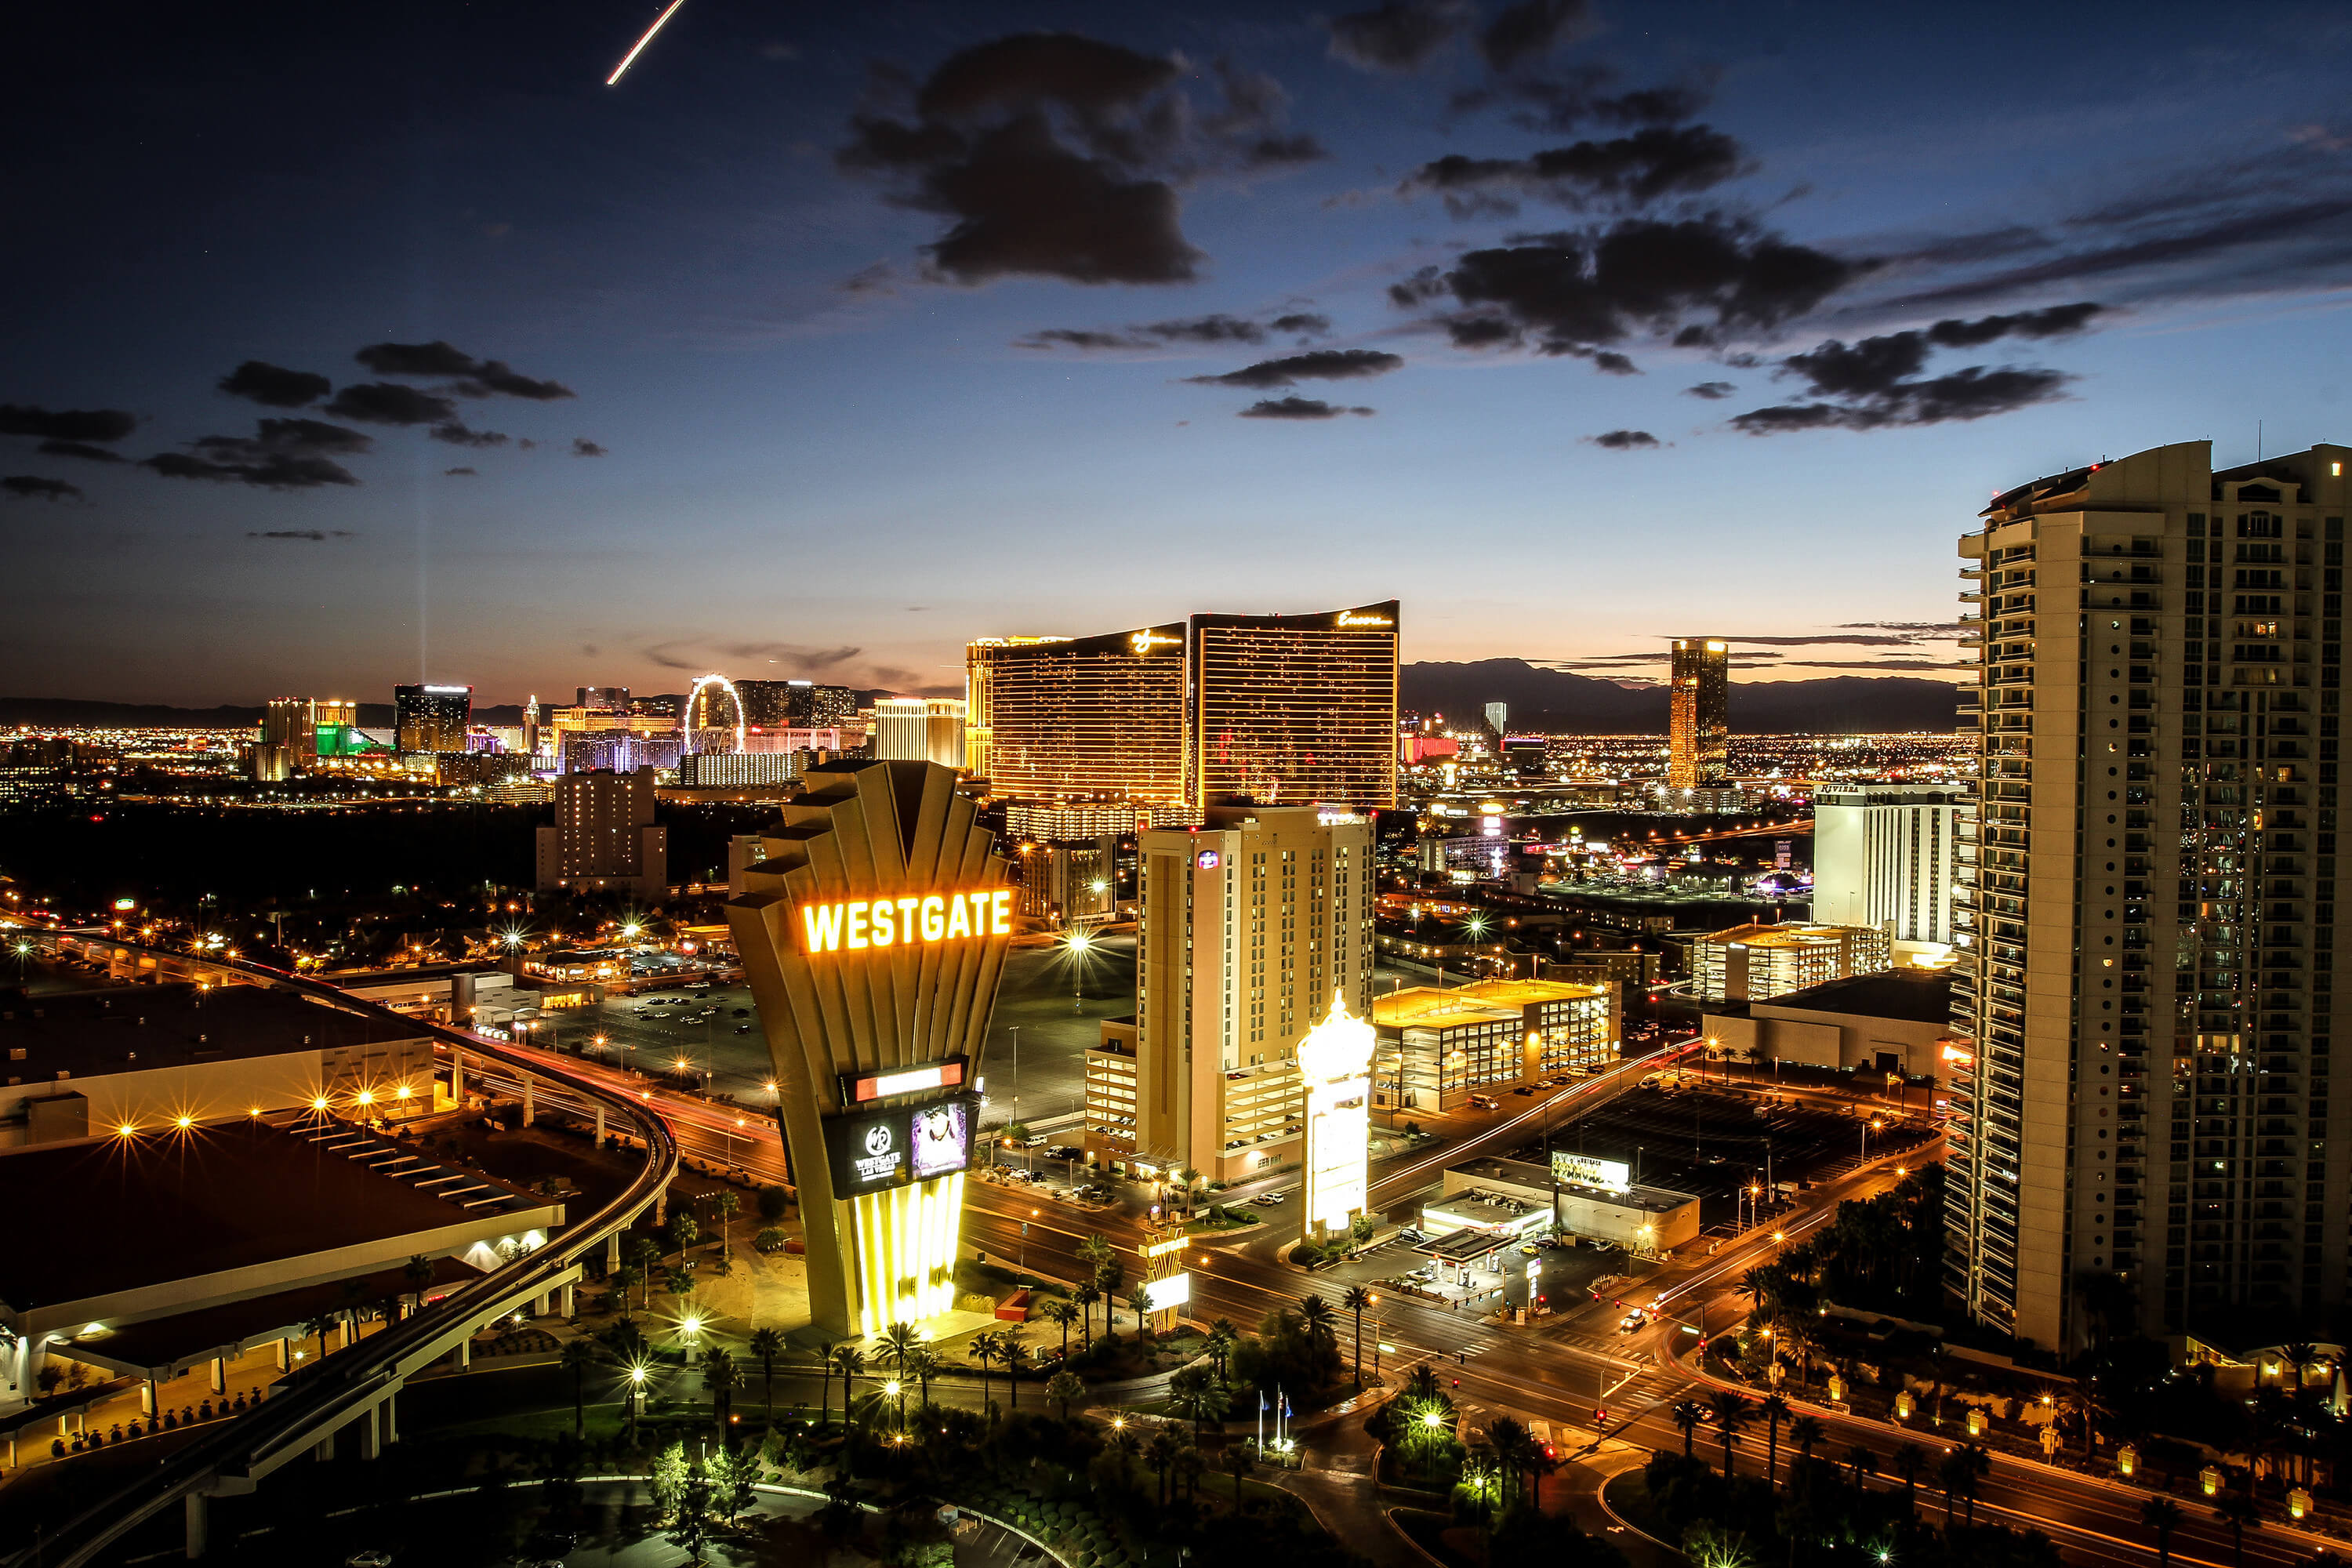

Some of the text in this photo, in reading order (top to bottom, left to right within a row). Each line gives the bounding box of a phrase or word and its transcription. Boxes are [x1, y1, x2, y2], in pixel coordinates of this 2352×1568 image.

[804, 890, 1011, 953] WESTGATE
[855, 1152, 901, 1169] WESTGATE
[1149, 1236, 1189, 1257] WESTGATE
